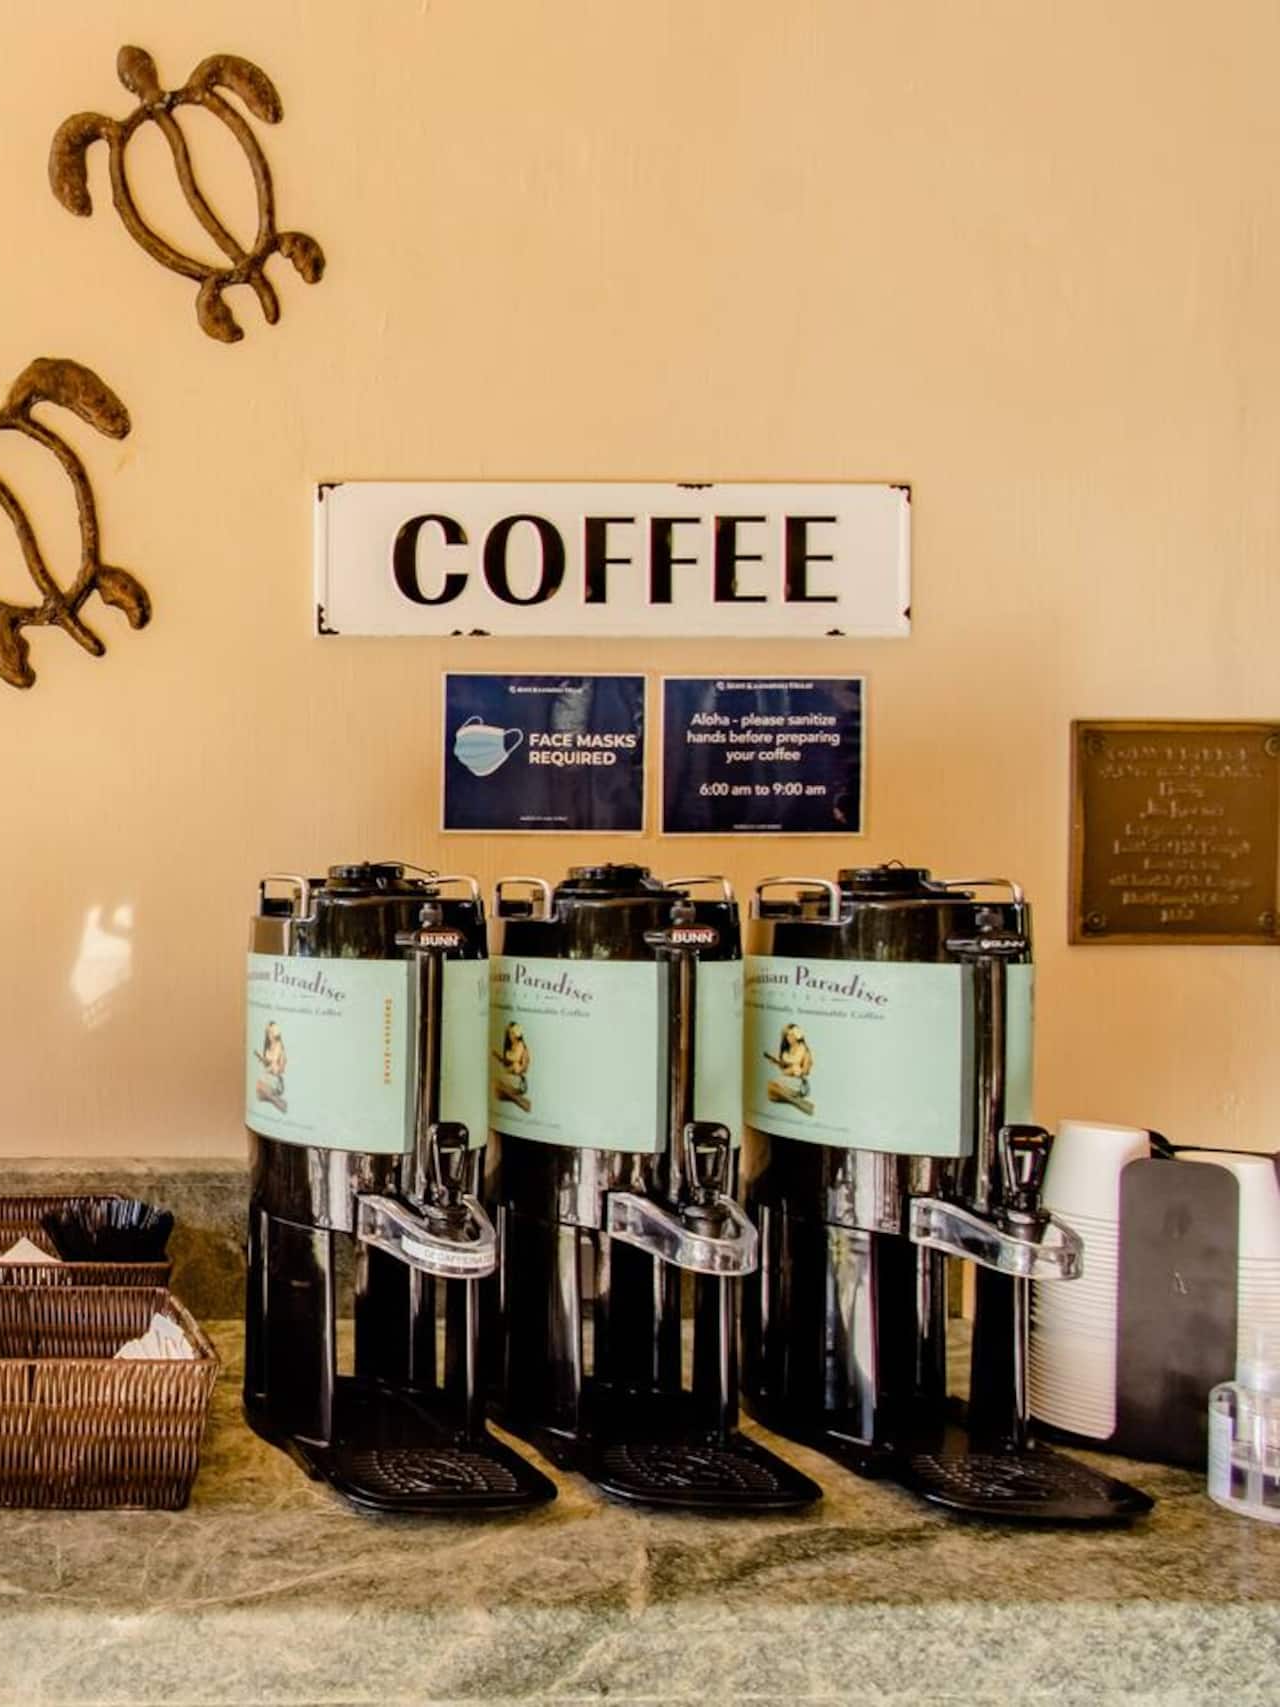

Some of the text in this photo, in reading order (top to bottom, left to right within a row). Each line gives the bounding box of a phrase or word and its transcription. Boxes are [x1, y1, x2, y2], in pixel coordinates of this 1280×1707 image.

[392, 513, 839, 605] COFFEE
[690, 712, 730, 727] Aloha
[740, 712, 785, 729] please
[787, 713, 837, 727] sanitize
[528, 733, 637, 748] FACE MASKS
[686, 729, 841, 747] hands before preparing
[528, 751, 617, 766] REQUIRED
[725, 747, 802, 764] your coffee
[699, 782, 827, 796] 6:00 am to 9:00 am
[420, 932, 460, 947] BUNN
[671, 928, 714, 943] BUNN
[273, 961, 346, 1001] Paradise
[515, 963, 594, 1002] Paradise
[795, 965, 889, 1006] Paradise
